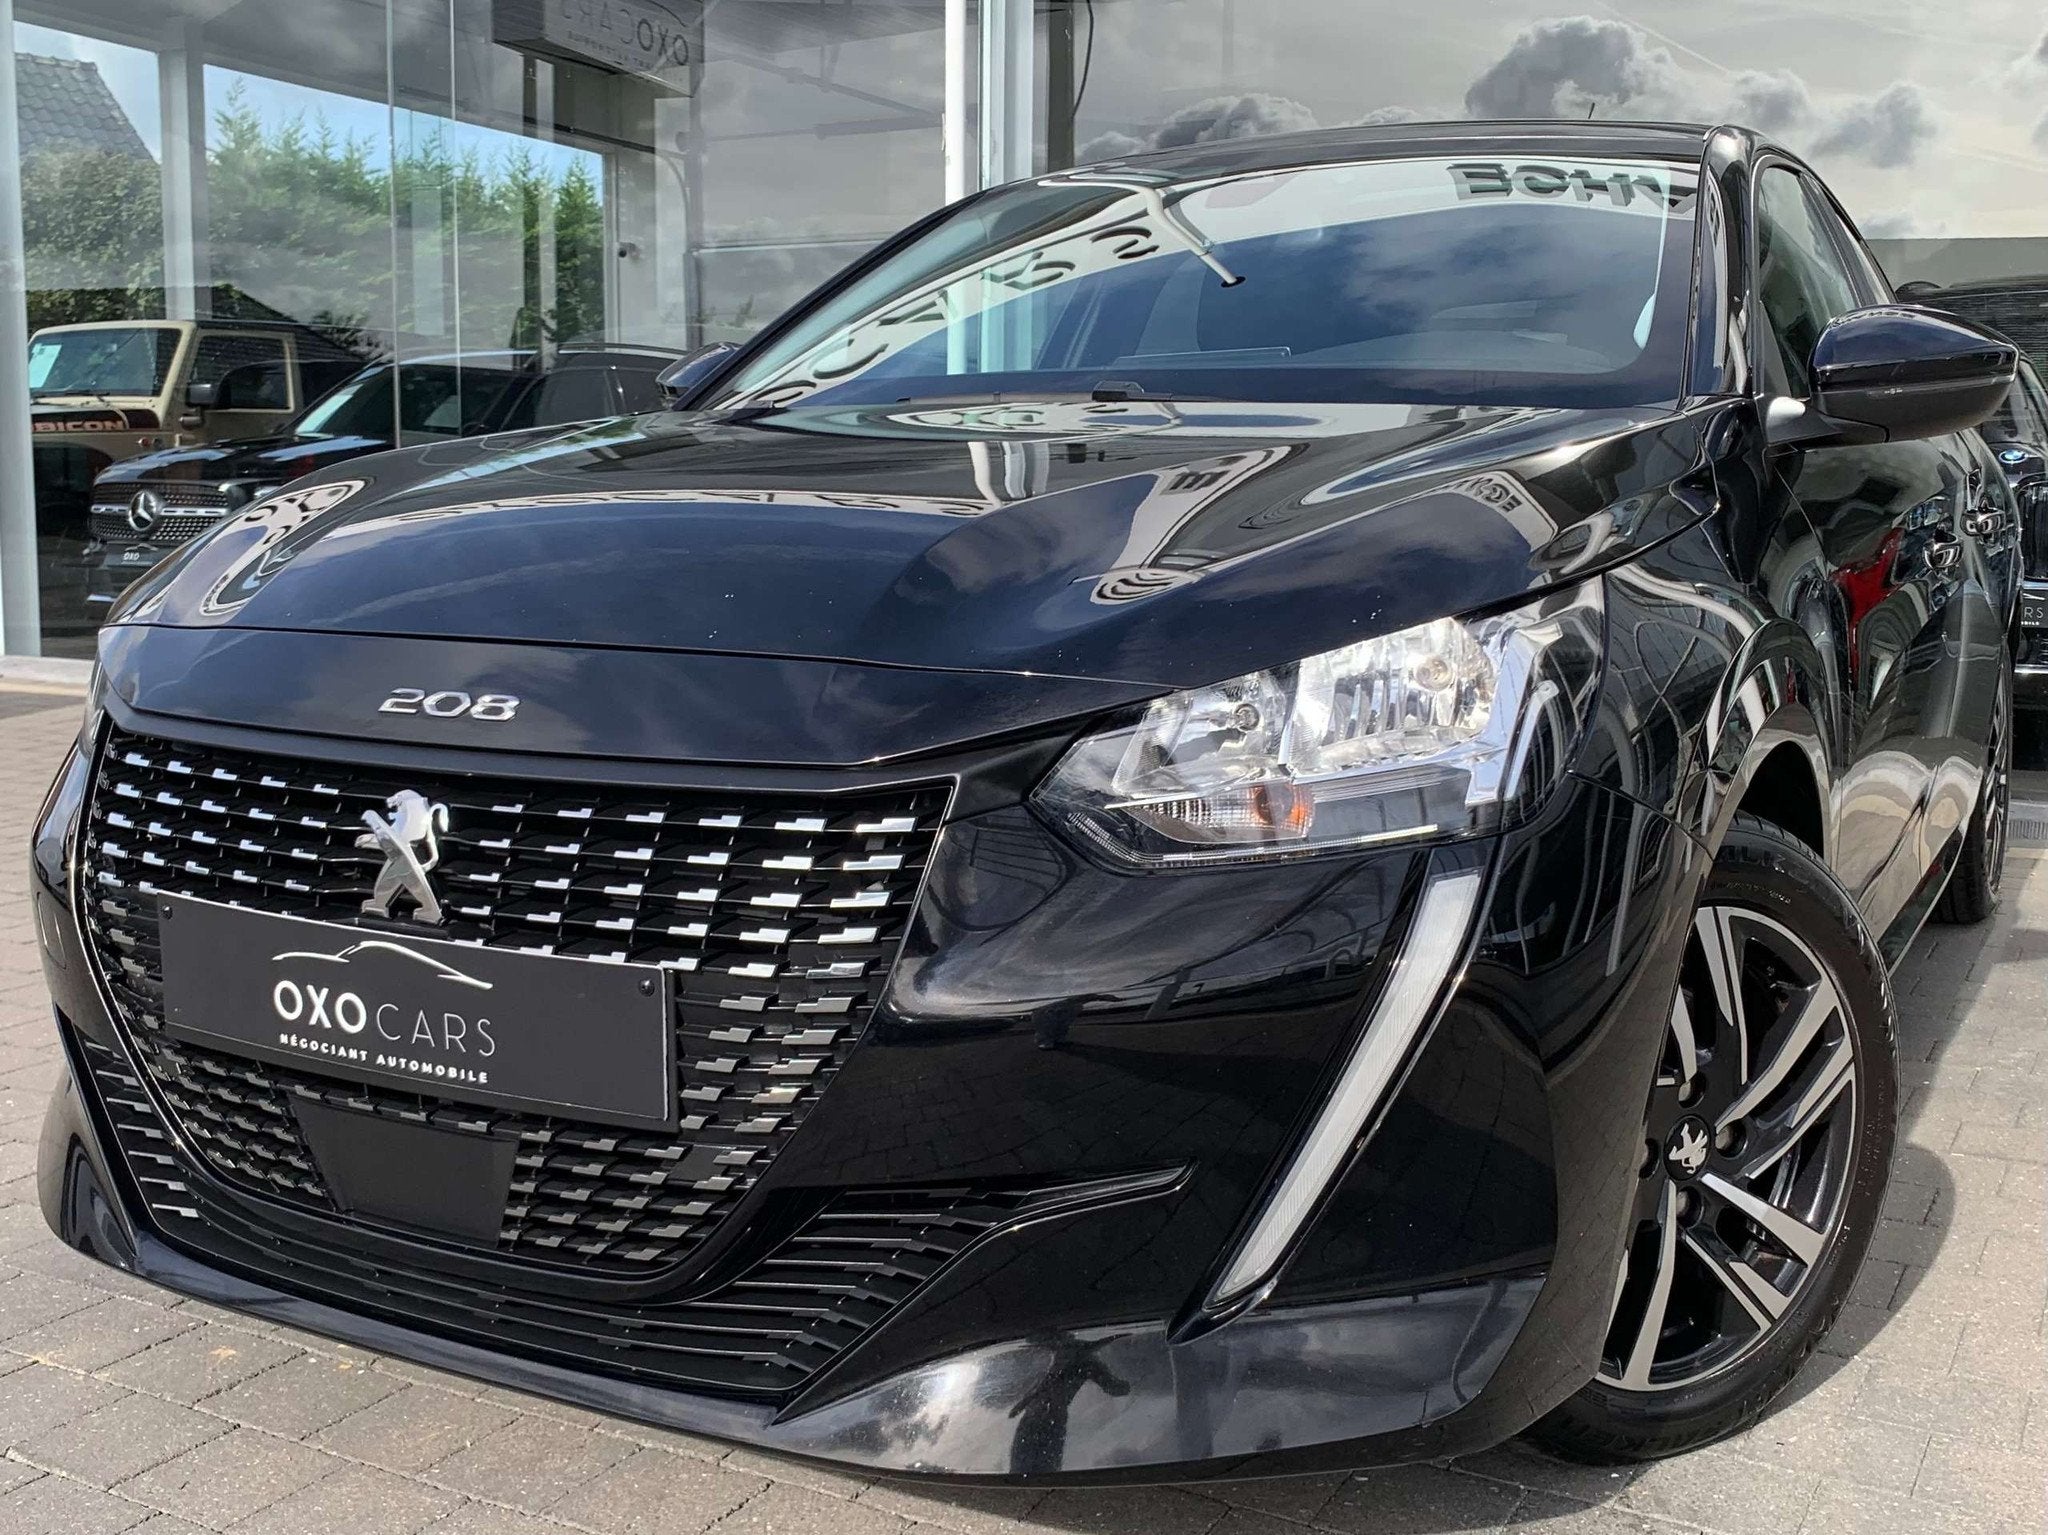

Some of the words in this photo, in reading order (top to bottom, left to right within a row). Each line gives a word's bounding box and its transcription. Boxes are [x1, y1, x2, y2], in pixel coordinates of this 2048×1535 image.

[32, 420, 125, 432] BICON
[378, 687, 521, 722] 208
[279, 1033, 368, 1062] NÉGOCIANT
[375, 1053, 489, 1084] AUTOMOBILE
